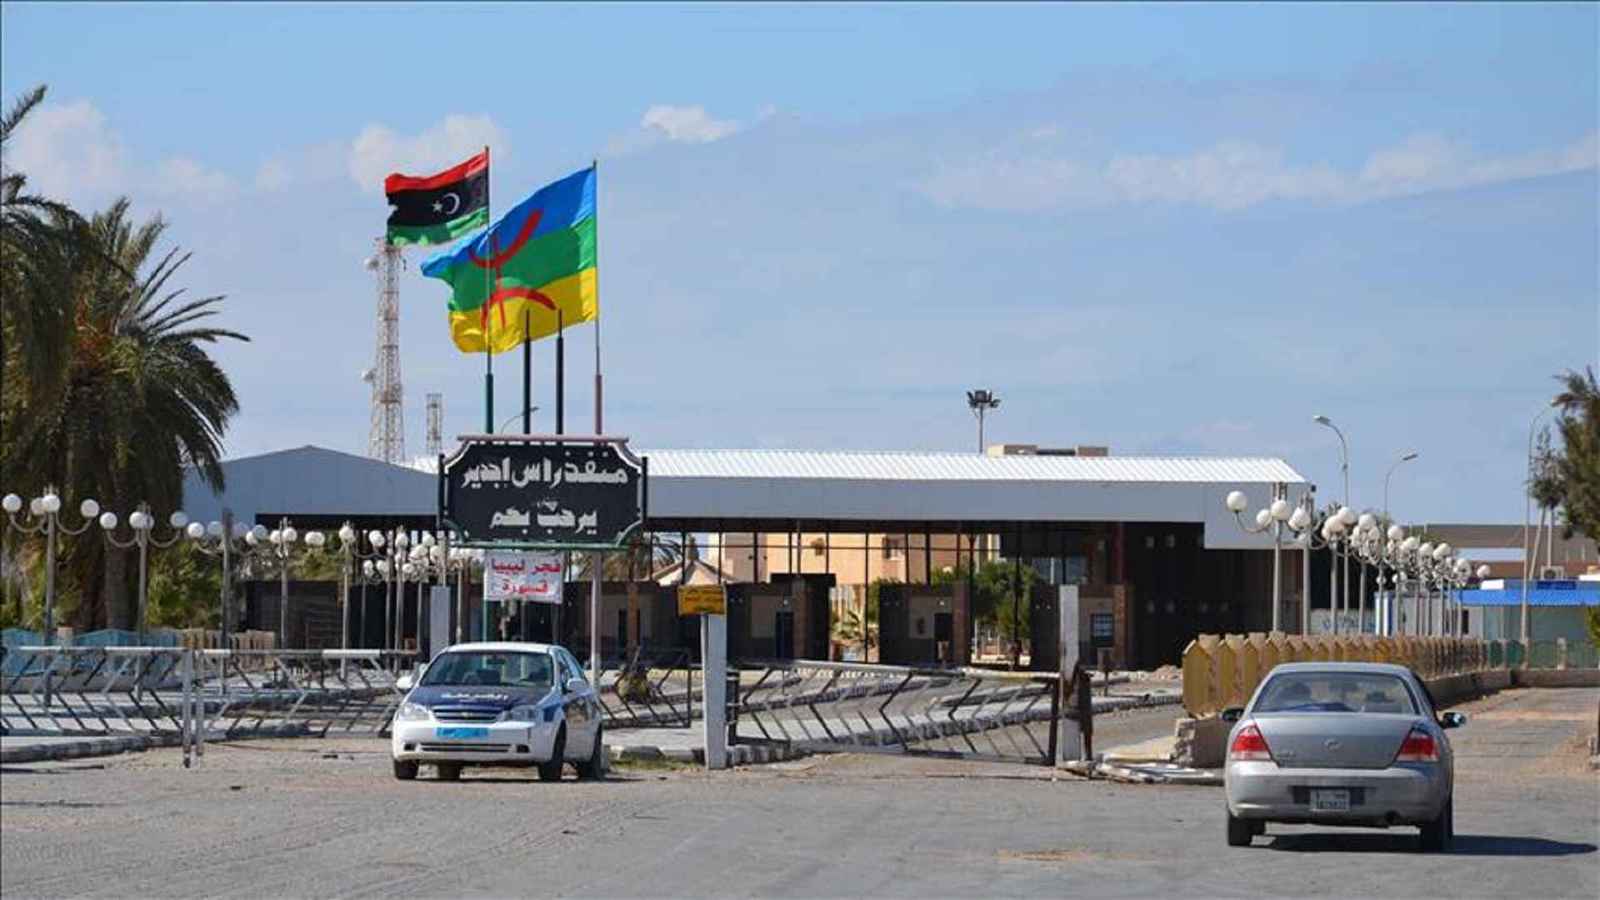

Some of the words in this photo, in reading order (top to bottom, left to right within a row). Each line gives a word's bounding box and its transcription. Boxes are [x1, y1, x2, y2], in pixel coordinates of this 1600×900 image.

[564, 451, 628, 485] منفذ
[489, 507, 530, 535] بكم
[537, 508, 598, 535] يرحب
[491, 558, 525, 575] ليبيا
[529, 559, 562, 575] فجر
